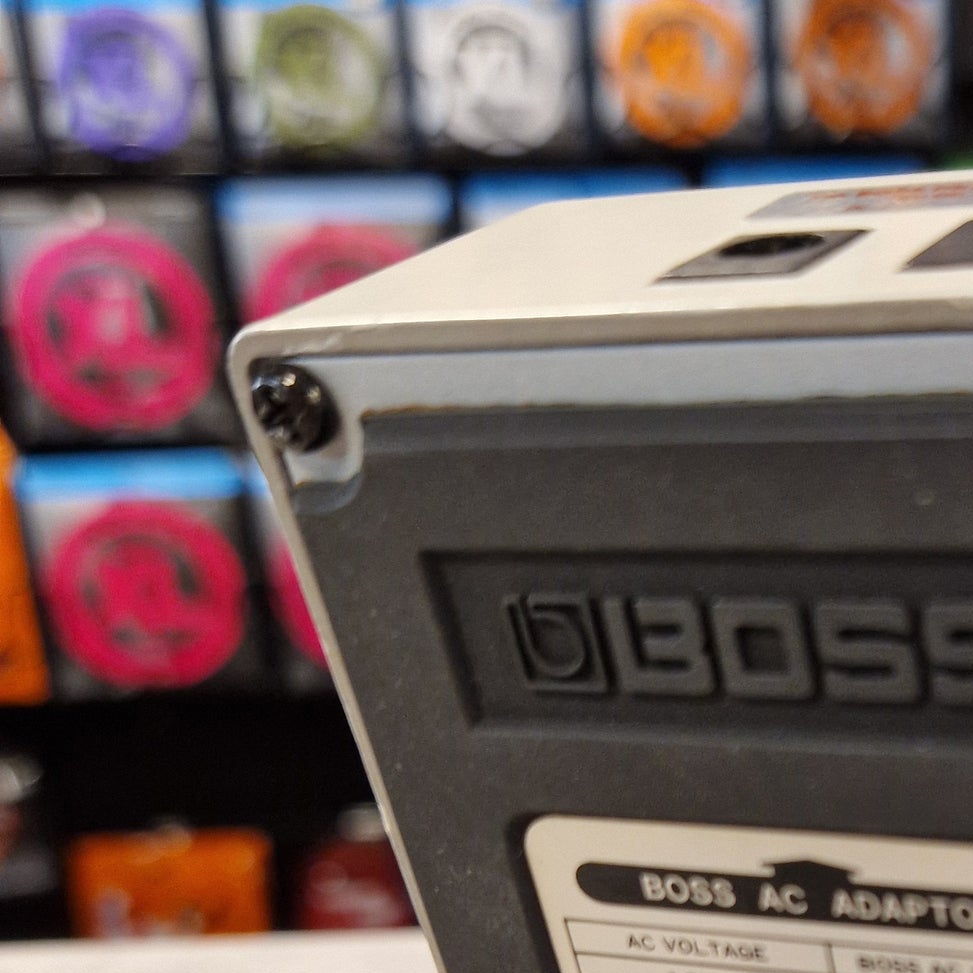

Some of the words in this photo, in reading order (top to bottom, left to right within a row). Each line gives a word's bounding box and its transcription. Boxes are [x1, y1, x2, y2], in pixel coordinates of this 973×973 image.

[639, 871, 736, 908] BOSS
[758, 882, 808, 915] AC
[628, 934, 655, 951] AC
[663, 936, 768, 962] VOLTAGE
